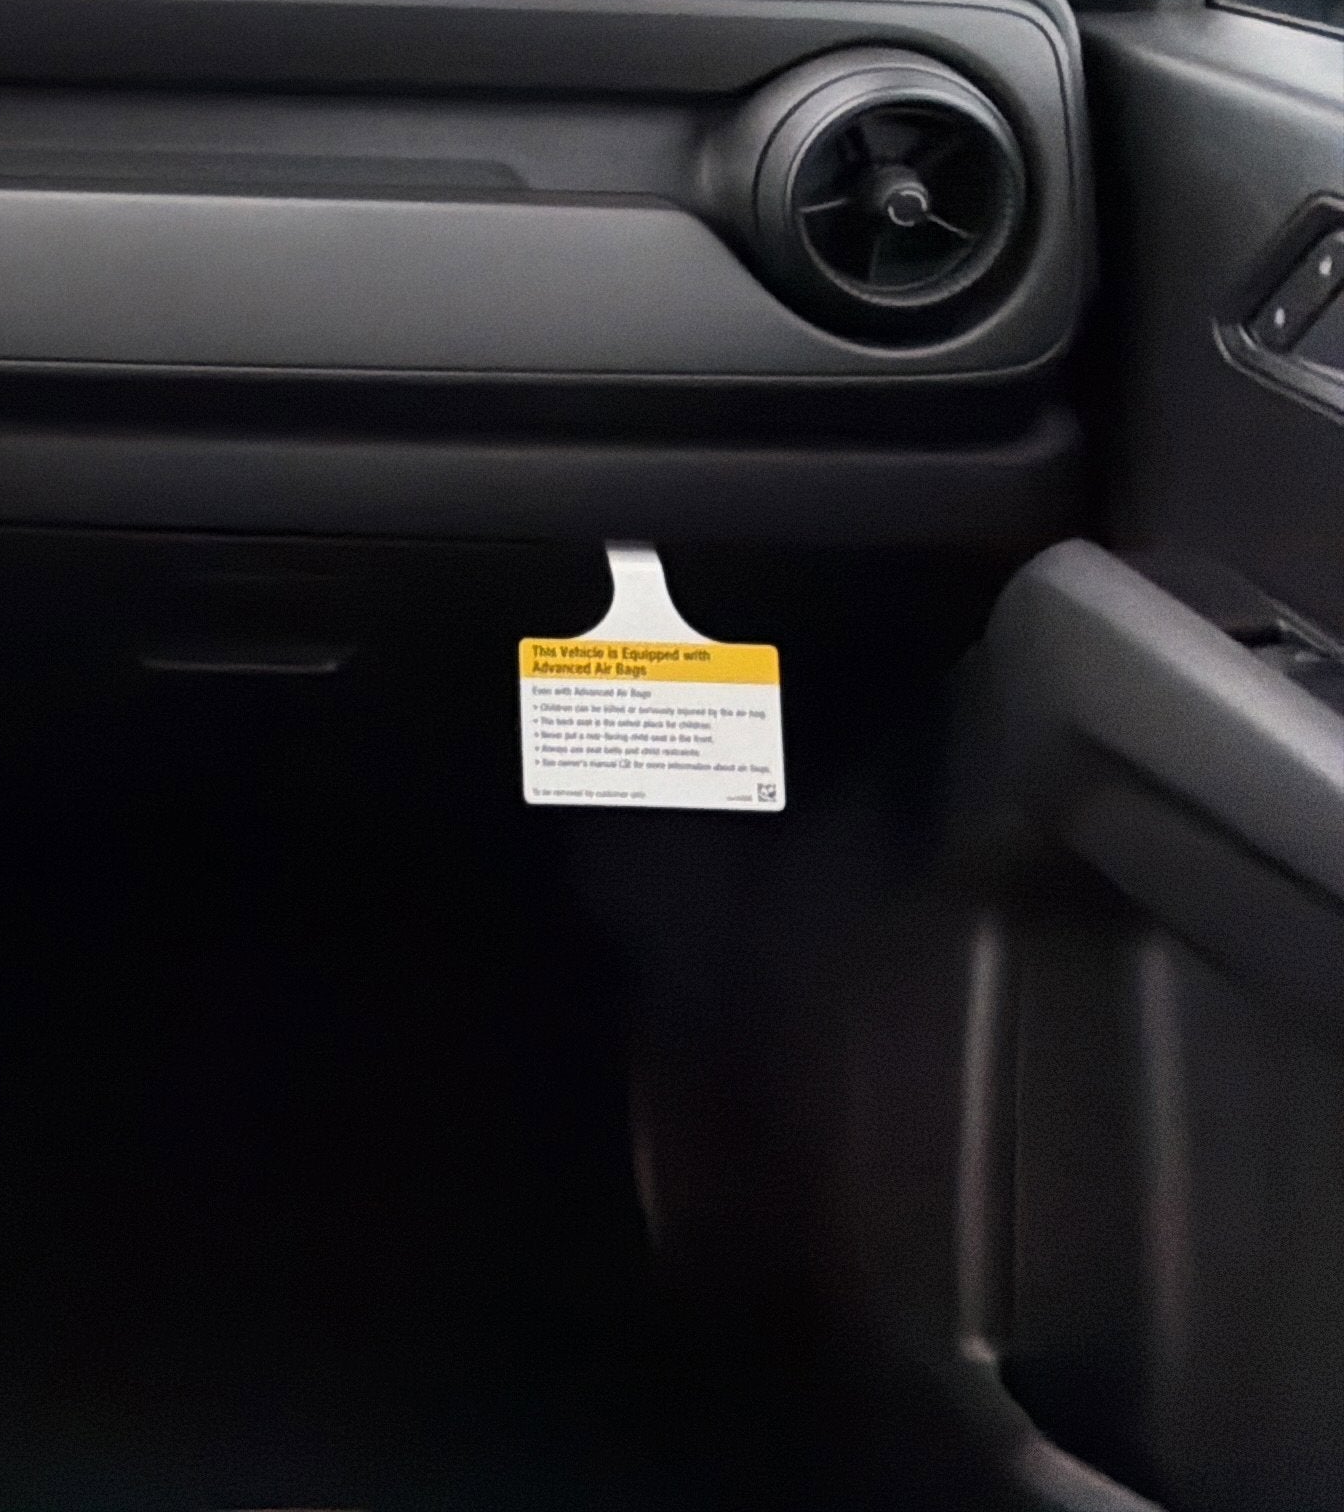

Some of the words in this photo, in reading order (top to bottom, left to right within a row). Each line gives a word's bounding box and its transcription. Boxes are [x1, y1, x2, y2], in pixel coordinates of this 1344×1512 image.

[532, 645, 557, 658] This
[561, 646, 604, 659] Vehicle
[608, 647, 617, 659] is
[623, 648, 679, 662] Equipped
[684, 650, 711, 661] with
[532, 661, 591, 675] Advanced
[595, 662, 611, 675] Air
[616, 663, 647, 677] Bags
